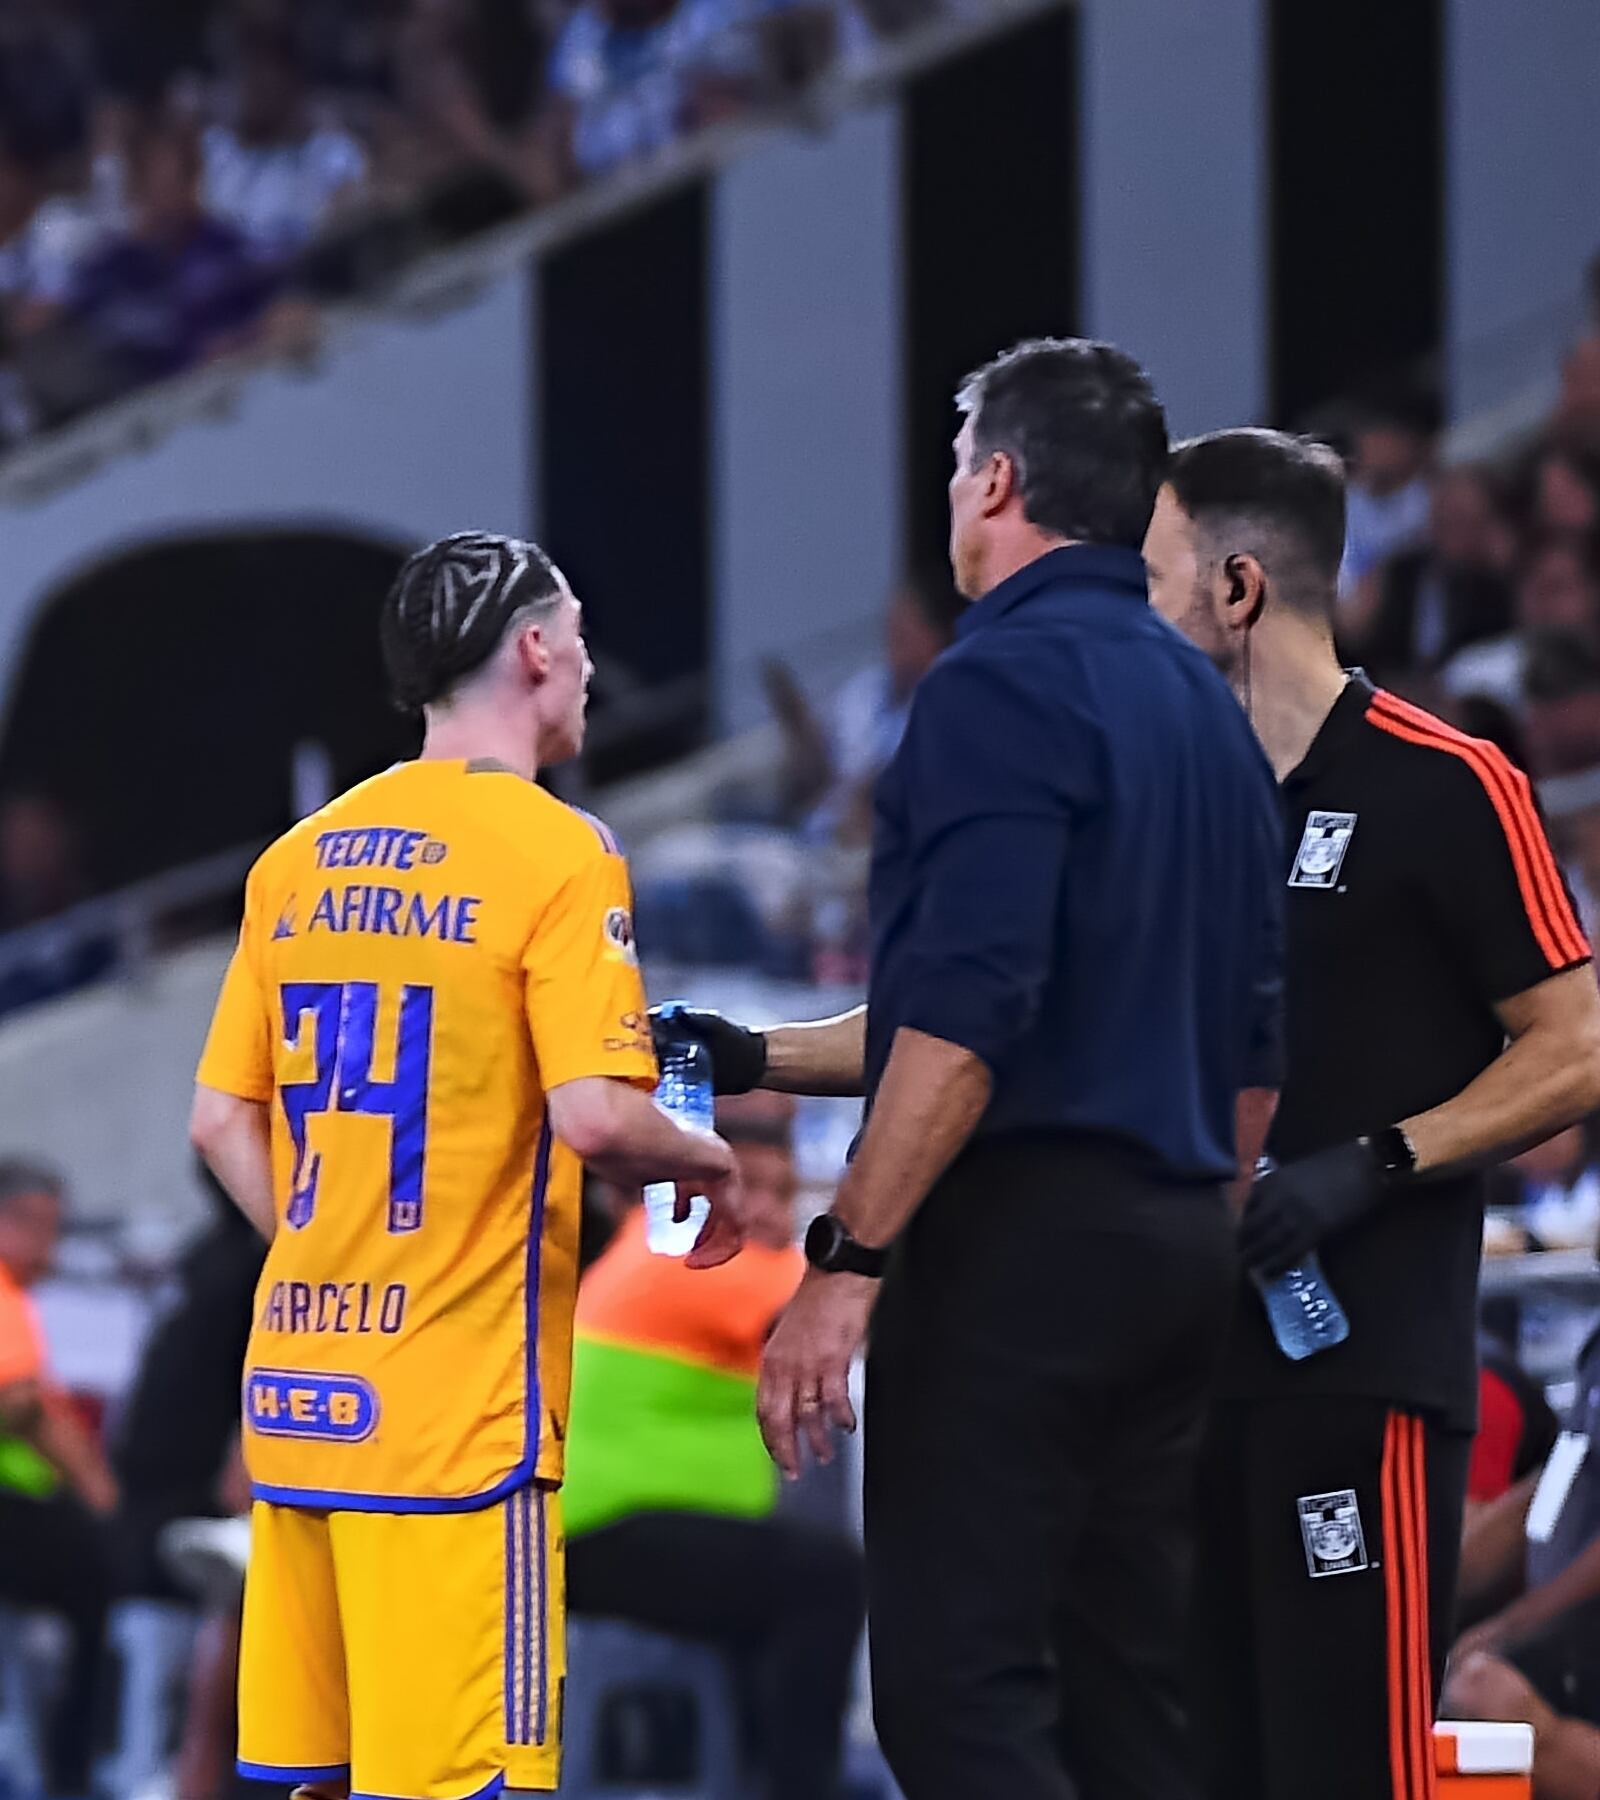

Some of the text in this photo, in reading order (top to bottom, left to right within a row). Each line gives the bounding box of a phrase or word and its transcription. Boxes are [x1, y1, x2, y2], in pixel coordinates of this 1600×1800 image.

[316, 827, 428, 870] TECATE
[309, 884, 483, 944] AFIRME
[280, 981, 434, 1233] 24
